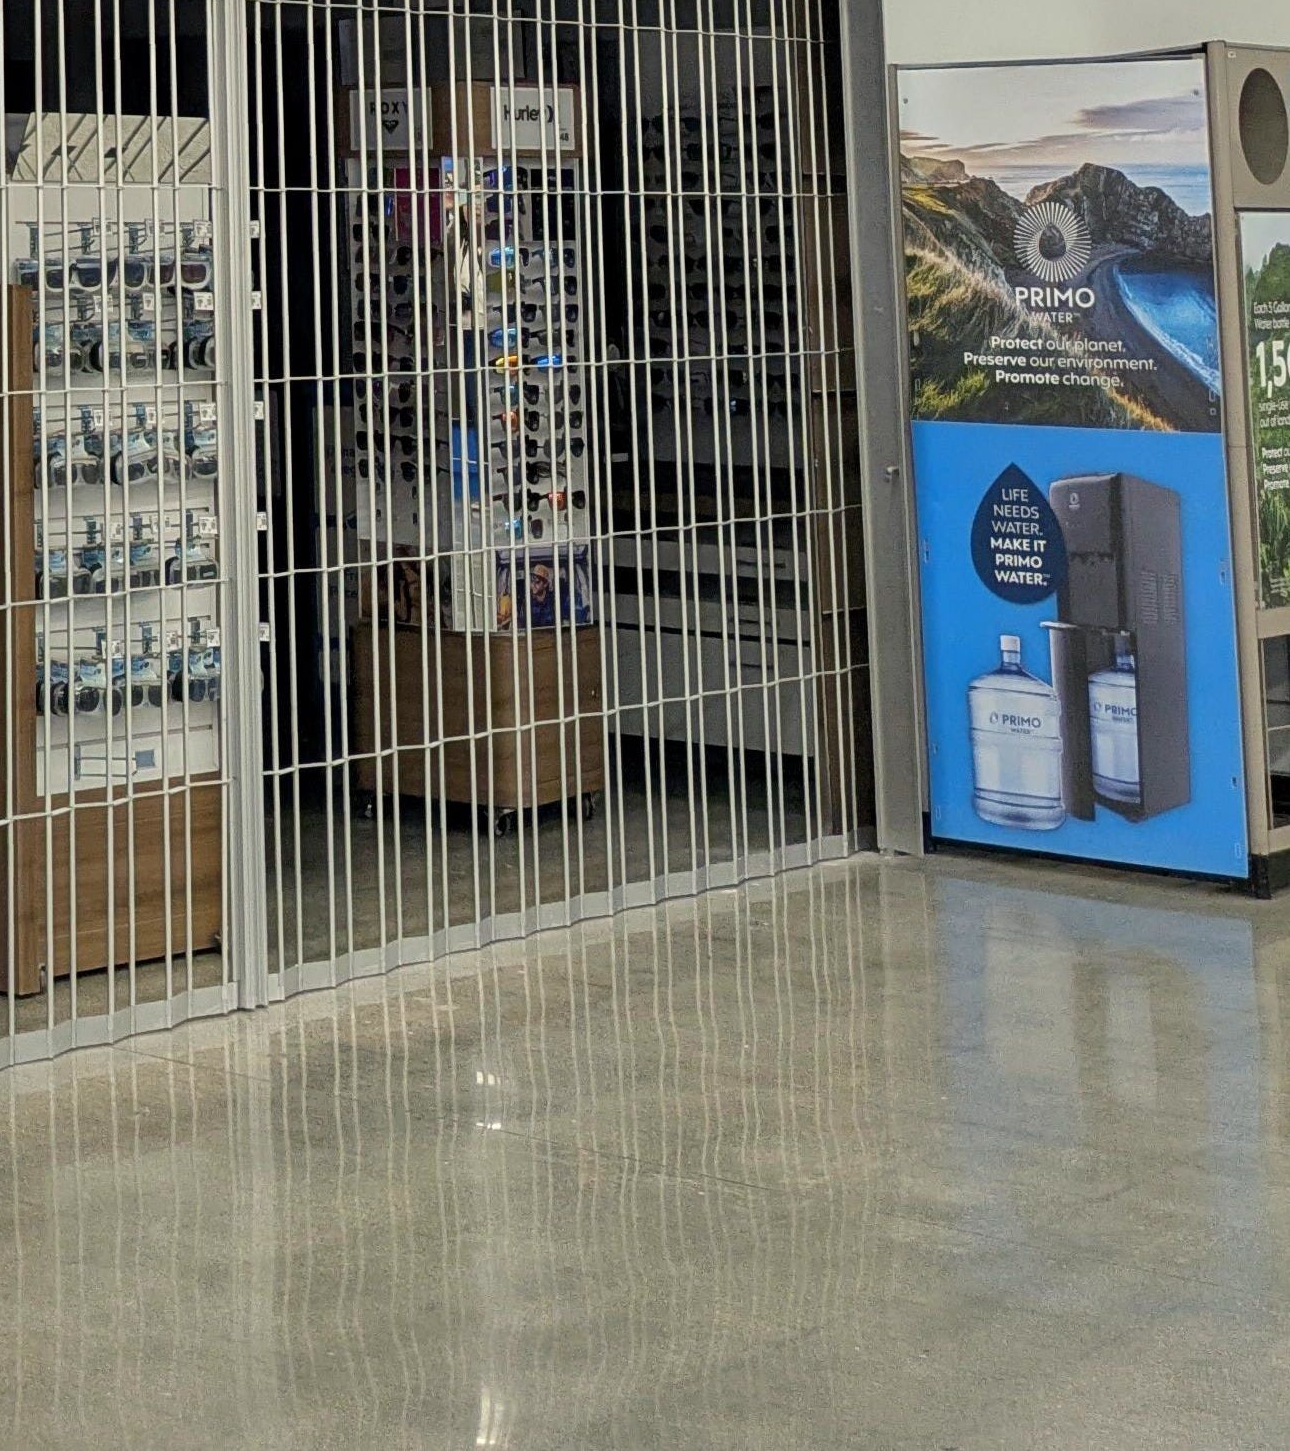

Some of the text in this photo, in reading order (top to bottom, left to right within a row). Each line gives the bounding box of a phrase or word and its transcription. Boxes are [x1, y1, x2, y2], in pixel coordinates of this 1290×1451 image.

[1015, 287, 1096, 309] PRIMO
[990, 336, 1127, 354] Protect our planet.
[963, 352, 1158, 371] Preserve our environment.
[1256, 339, 1290, 398] 1,5
[995, 370, 1125, 389] Promote change.
[1001, 488, 1029, 502] LIFE
[993, 505, 1040, 519] NEEDS
[991, 520, 1044, 536] WATER.
[990, 537, 1047, 553] MAKE IT
[995, 554, 1043, 569] PRIMO
[1001, 714, 1042, 728] PRIMO
